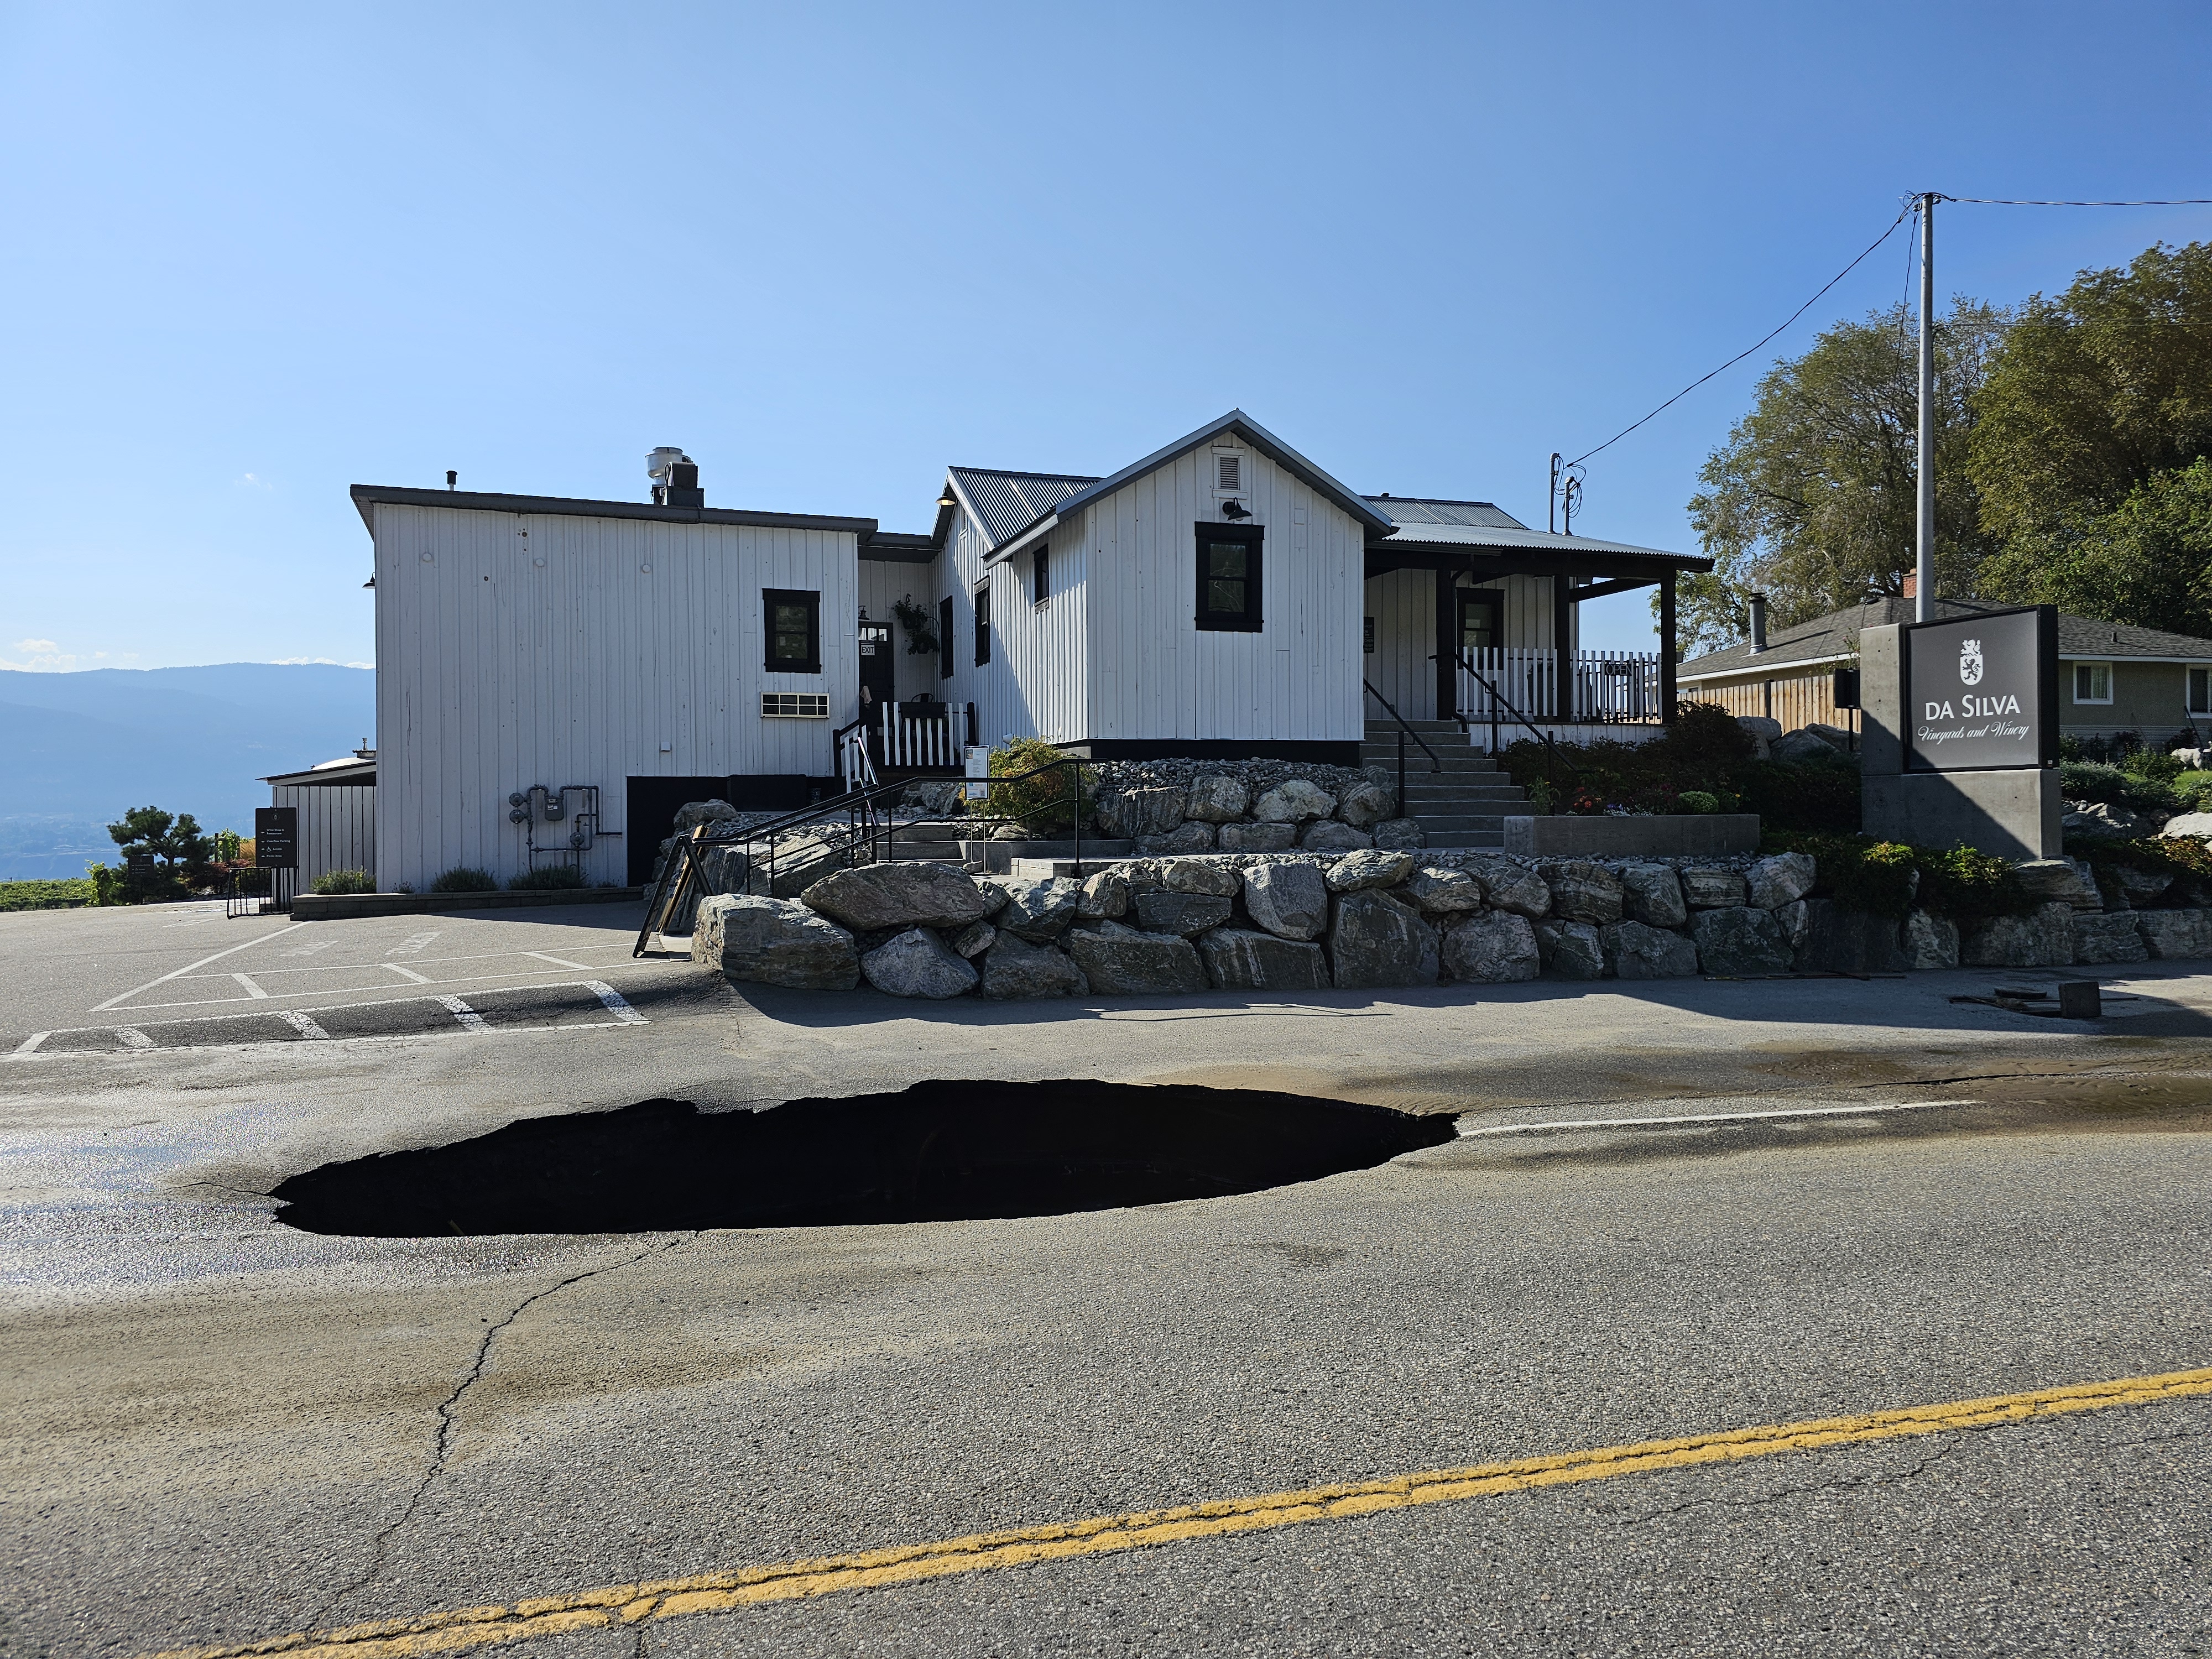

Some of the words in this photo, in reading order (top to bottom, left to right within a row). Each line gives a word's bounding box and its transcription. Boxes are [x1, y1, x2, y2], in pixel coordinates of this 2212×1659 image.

[1606, 664, 1632, 675] OPEN
[1926, 700, 1955, 721] DA
[1961, 694, 2021, 718] SILVA
[1917, 726, 1965, 745] Vineyards
[1966, 724, 1990, 738] and
[1991, 721, 2030, 740] Winery
